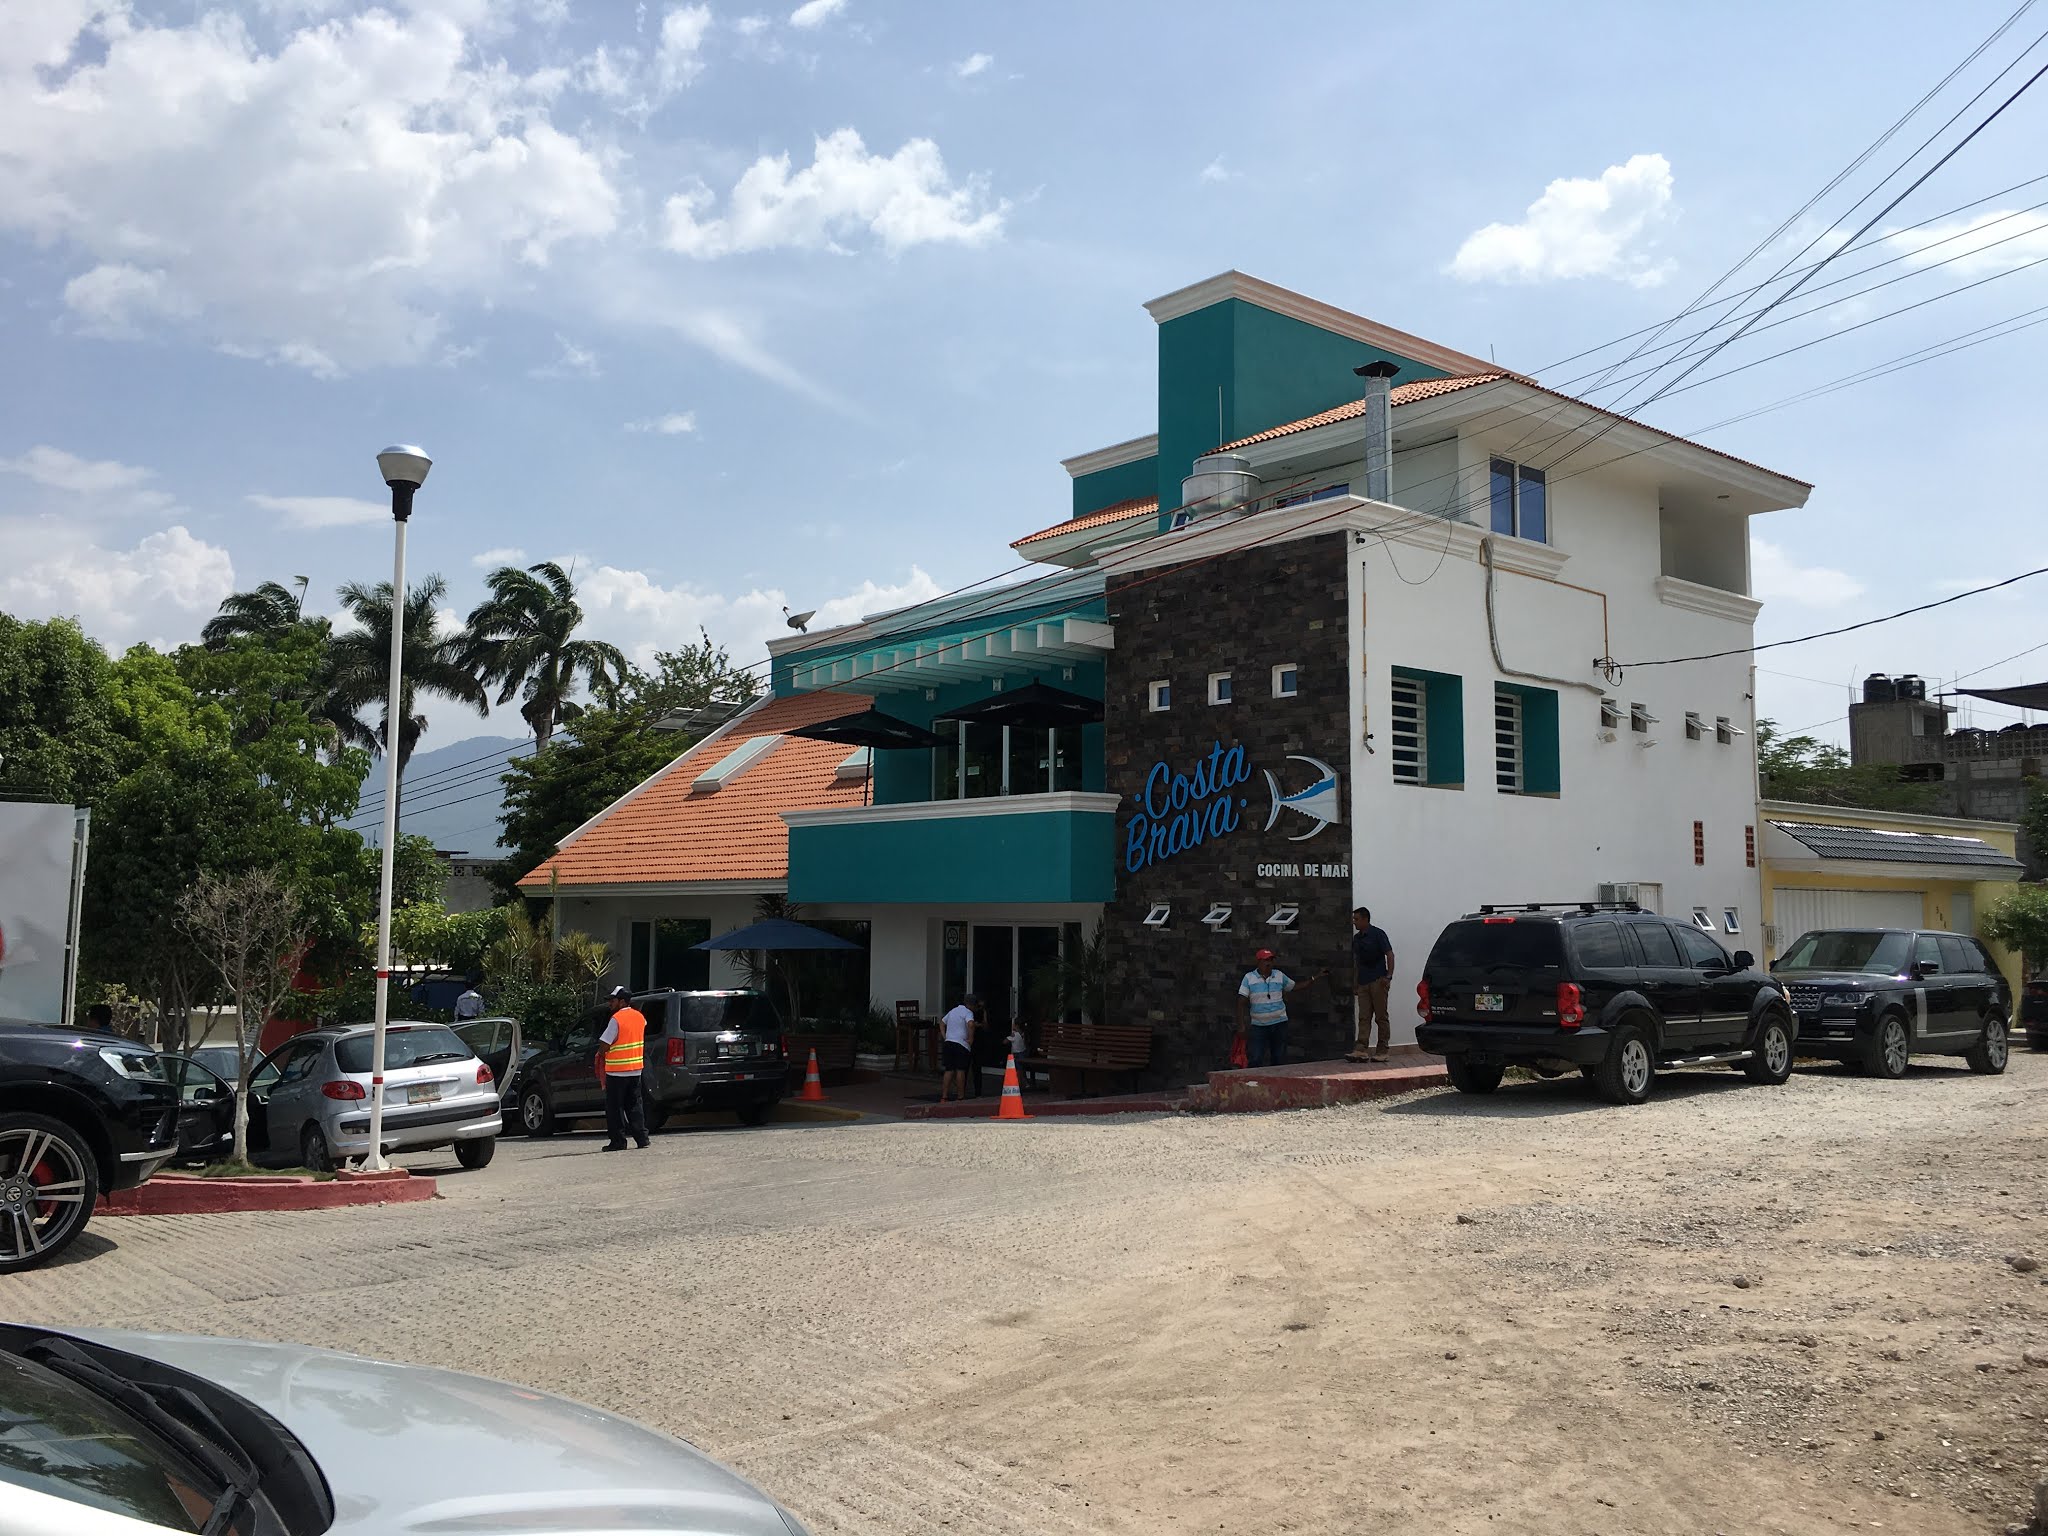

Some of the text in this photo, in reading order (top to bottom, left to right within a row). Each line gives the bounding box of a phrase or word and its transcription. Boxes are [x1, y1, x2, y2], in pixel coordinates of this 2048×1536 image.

[1144, 740, 1252, 821] Costa
[1125, 794, 1241, 873] Brava
[1257, 863, 1349, 878] COCINA DE MAR
